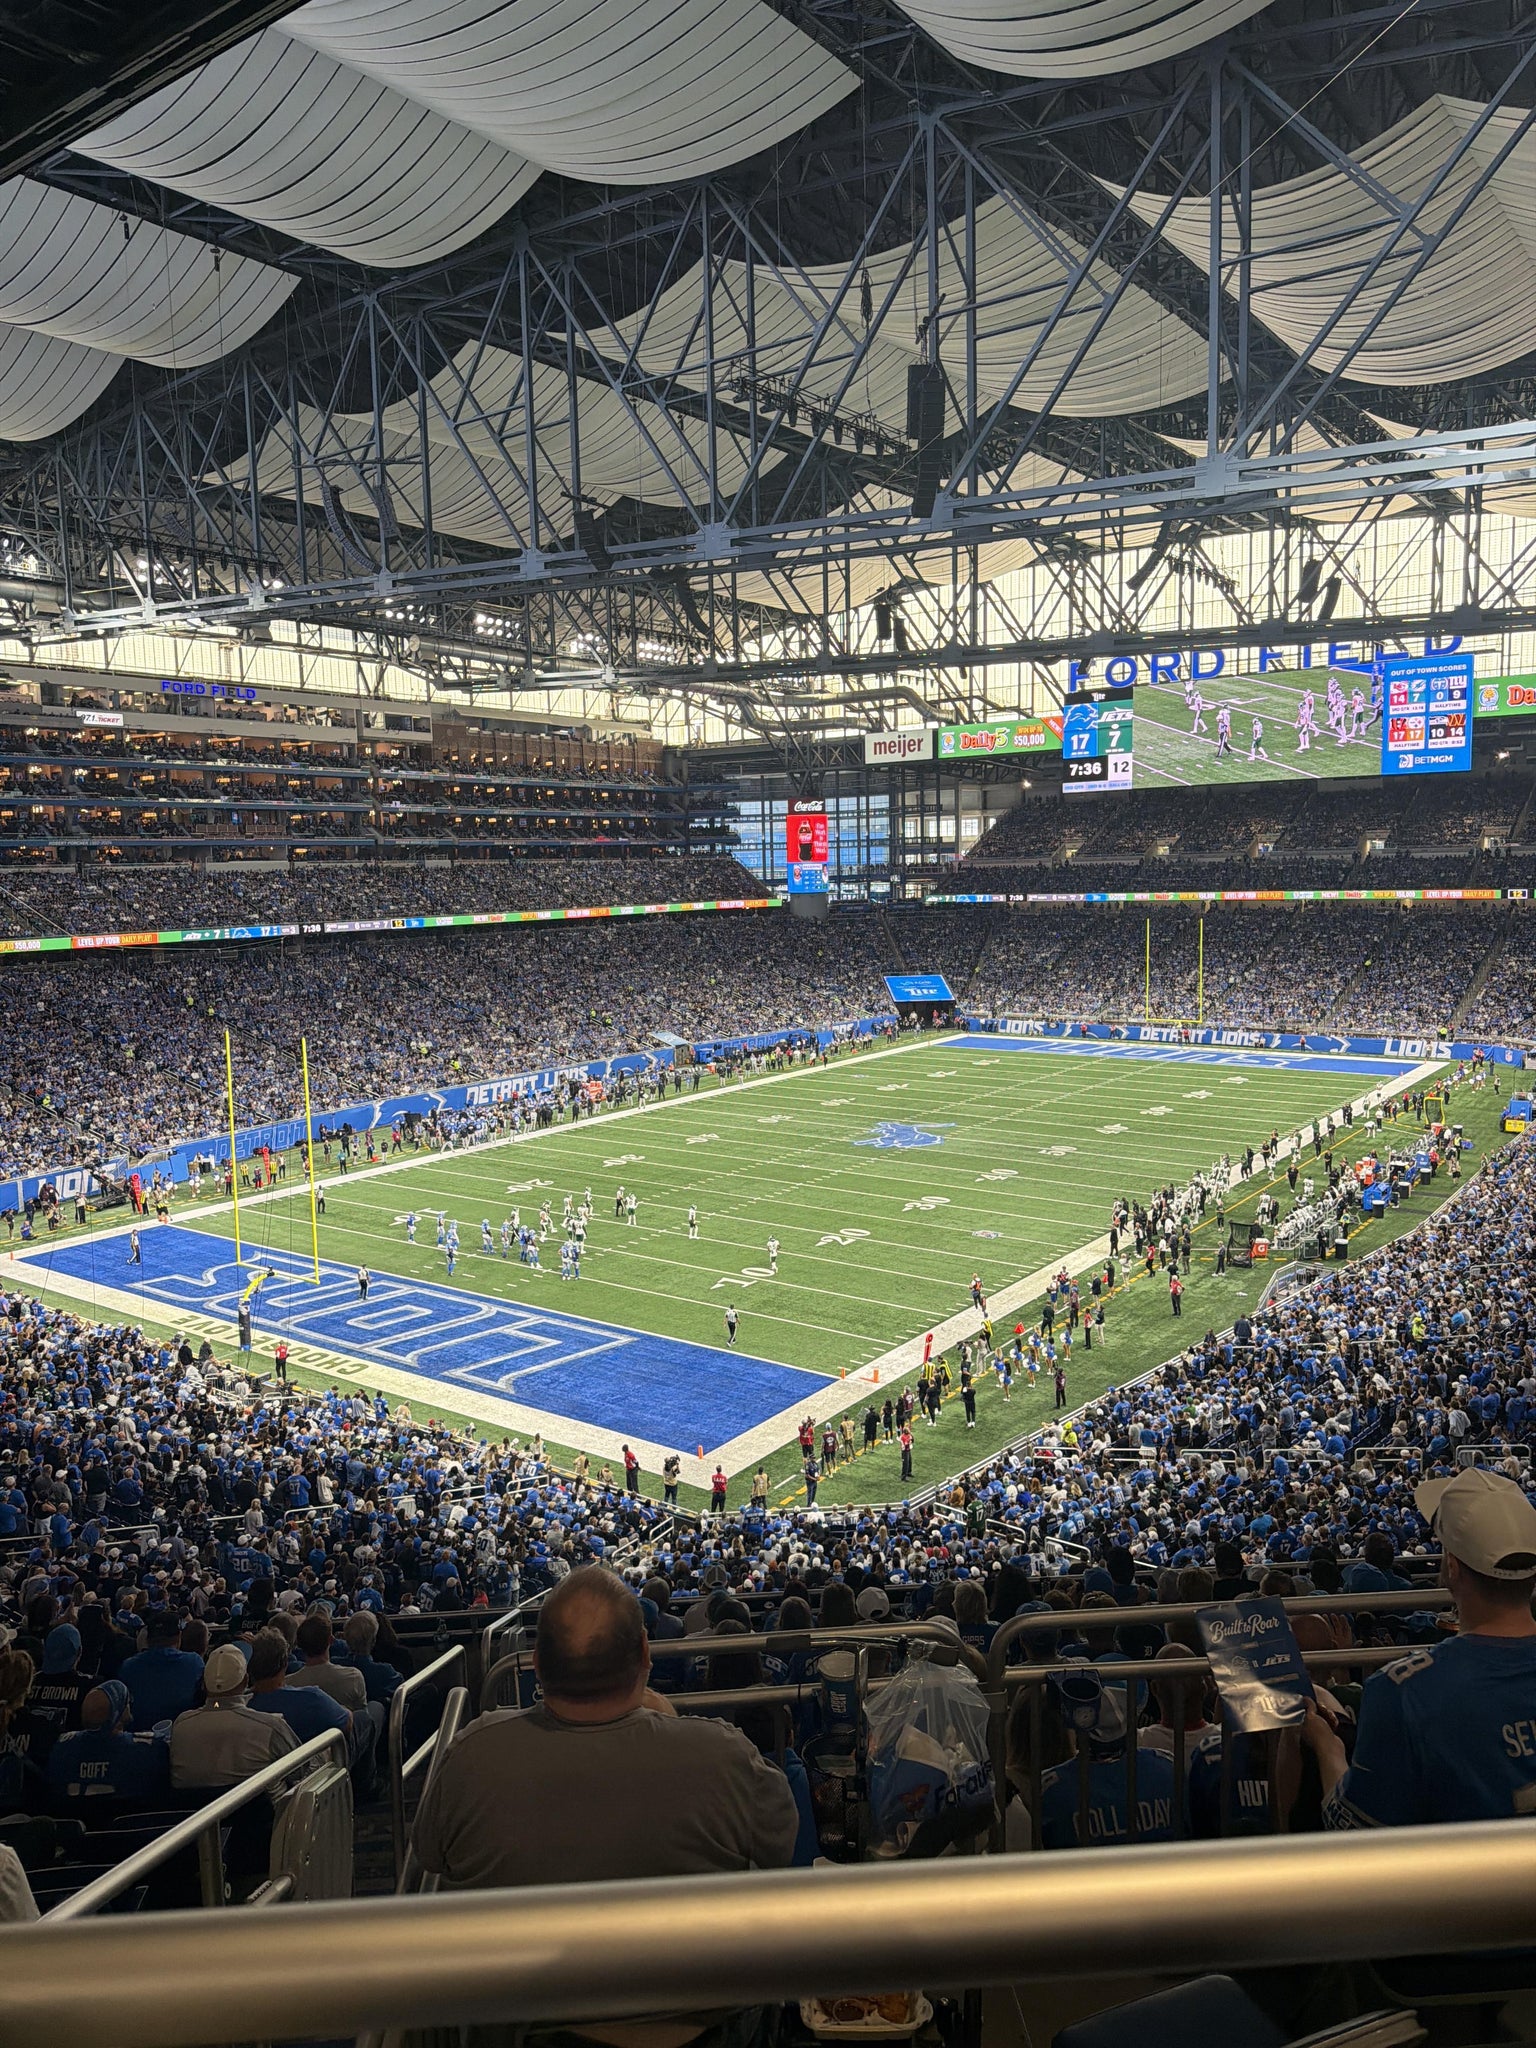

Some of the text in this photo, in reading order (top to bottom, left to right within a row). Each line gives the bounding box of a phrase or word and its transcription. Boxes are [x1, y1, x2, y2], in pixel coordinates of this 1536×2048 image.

[1068, 650, 1225, 693] FORD
[1438, 664, 1467, 672] SCORES
[161, 680, 257, 699] FORD FIELD
[1436, 691, 1444, 700] 0
[1453, 690, 1461, 699] 9
[1507, 685, 1536, 707] Da
[1393, 695, 1406, 704] 14
[1413, 693, 1420, 702] 7
[1100, 707, 1133, 722] JETS
[1049, 719, 1062, 734] NEW!
[1431, 728, 1444, 737] 10
[1450, 727, 1463, 736] 14
[960, 727, 1010, 752] Daily 5
[1014, 733, 1045, 746] $50,000
[1109, 731, 1121, 748] 7
[1393, 731, 1405, 739] 17
[1410, 730, 1422, 738] 17
[873, 735, 924, 758] meijer
[1071, 733, 1090, 750] 17
[1414, 755, 1453, 764] BETMGM
[1069, 762, 1102, 776] 7:36
[1112, 761, 1130, 773] 12
[794, 801, 824, 812] Coca-Cola
[213, 930, 220, 939] 7
[260, 927, 270, 936] 17
[289, 926, 296, 934] 3
[302, 924, 321, 933] 7:36
[14, 940, 41, 949] $50,000
[77, 934, 153, 946] LEVEL UP YOUR DAILY PLAY!
[998, 1019, 1045, 1036] LIONS
[1140, 1028, 1260, 1047] DETRIT LIONS
[1383, 1038, 1453, 1059] LIONS
[215, 1121, 309, 1164] DETROIT
[975, 1168, 1018, 1182] 40
[504, 1178, 554, 1195] 20
[902, 1196, 951, 1212] 30
[815, 1228, 871, 1247] 20
[1257, 1244, 1265, 1252] G
[710, 1267, 776, 1290] 10
[123, 1251, 640, 1396] LIONS
[288, 1482, 301, 1495] 97
[477, 1537, 489, 1551] 20
[232, 1558, 250, 1573] 20
[1210, 1614, 1280, 1643] Built to Roar
[1262, 1654, 1291, 1667] JETS
[41, 1686, 79, 1701] BROWN
[1501, 1719, 1536, 1758] SE
[79, 1761, 110, 1779] GOFF
[1072, 1797, 1171, 1841] OLLDAY
